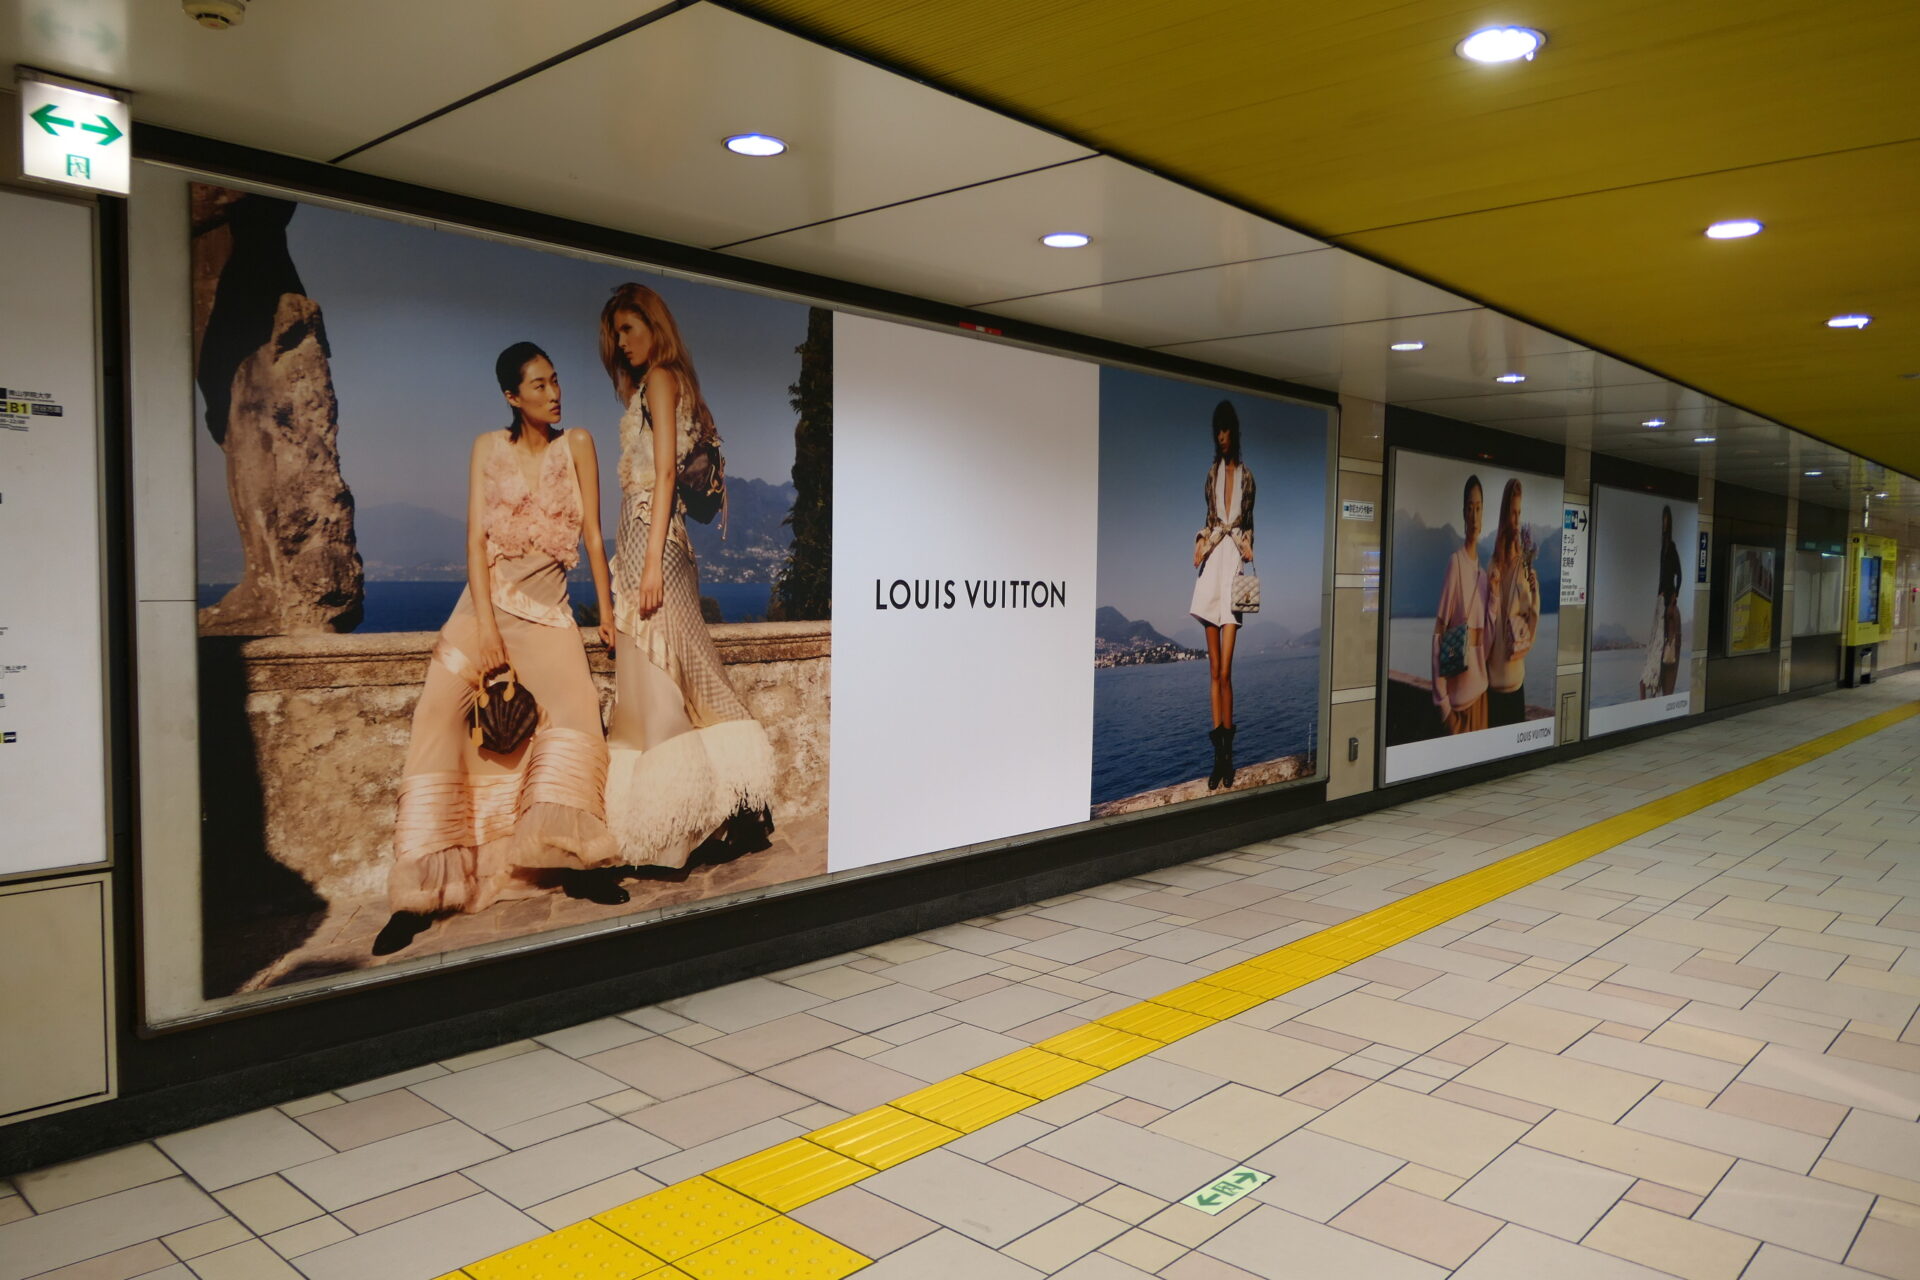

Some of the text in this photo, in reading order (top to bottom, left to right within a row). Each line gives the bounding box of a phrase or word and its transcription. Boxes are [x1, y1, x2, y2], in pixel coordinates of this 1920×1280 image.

[10, 402, 28, 414] B1
[876, 579, 1066, 610] LOUIS VUITTON
